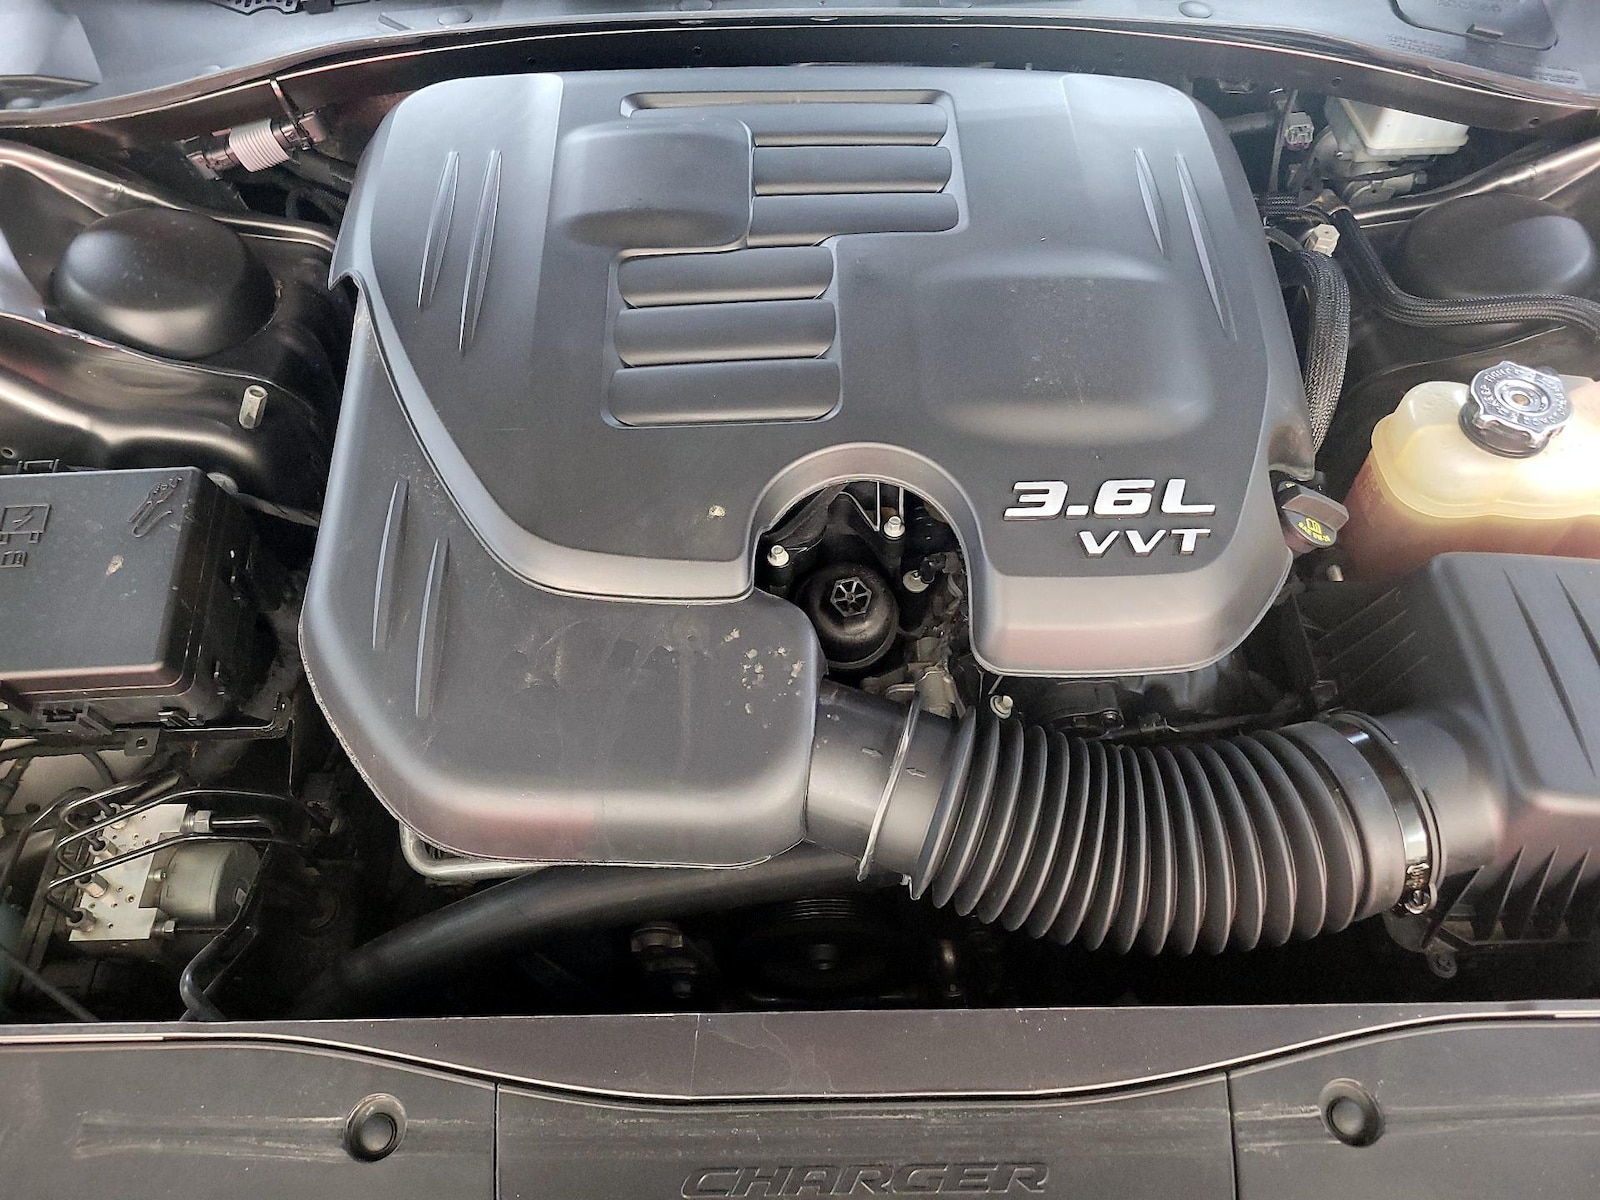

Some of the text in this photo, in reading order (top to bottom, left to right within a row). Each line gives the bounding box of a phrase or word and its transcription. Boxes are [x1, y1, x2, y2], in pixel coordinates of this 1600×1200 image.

[1003, 479, 1216, 520] 3.6L
[1078, 528, 1211, 557] VVT
[681, 1162, 1049, 1198] CHARGER
